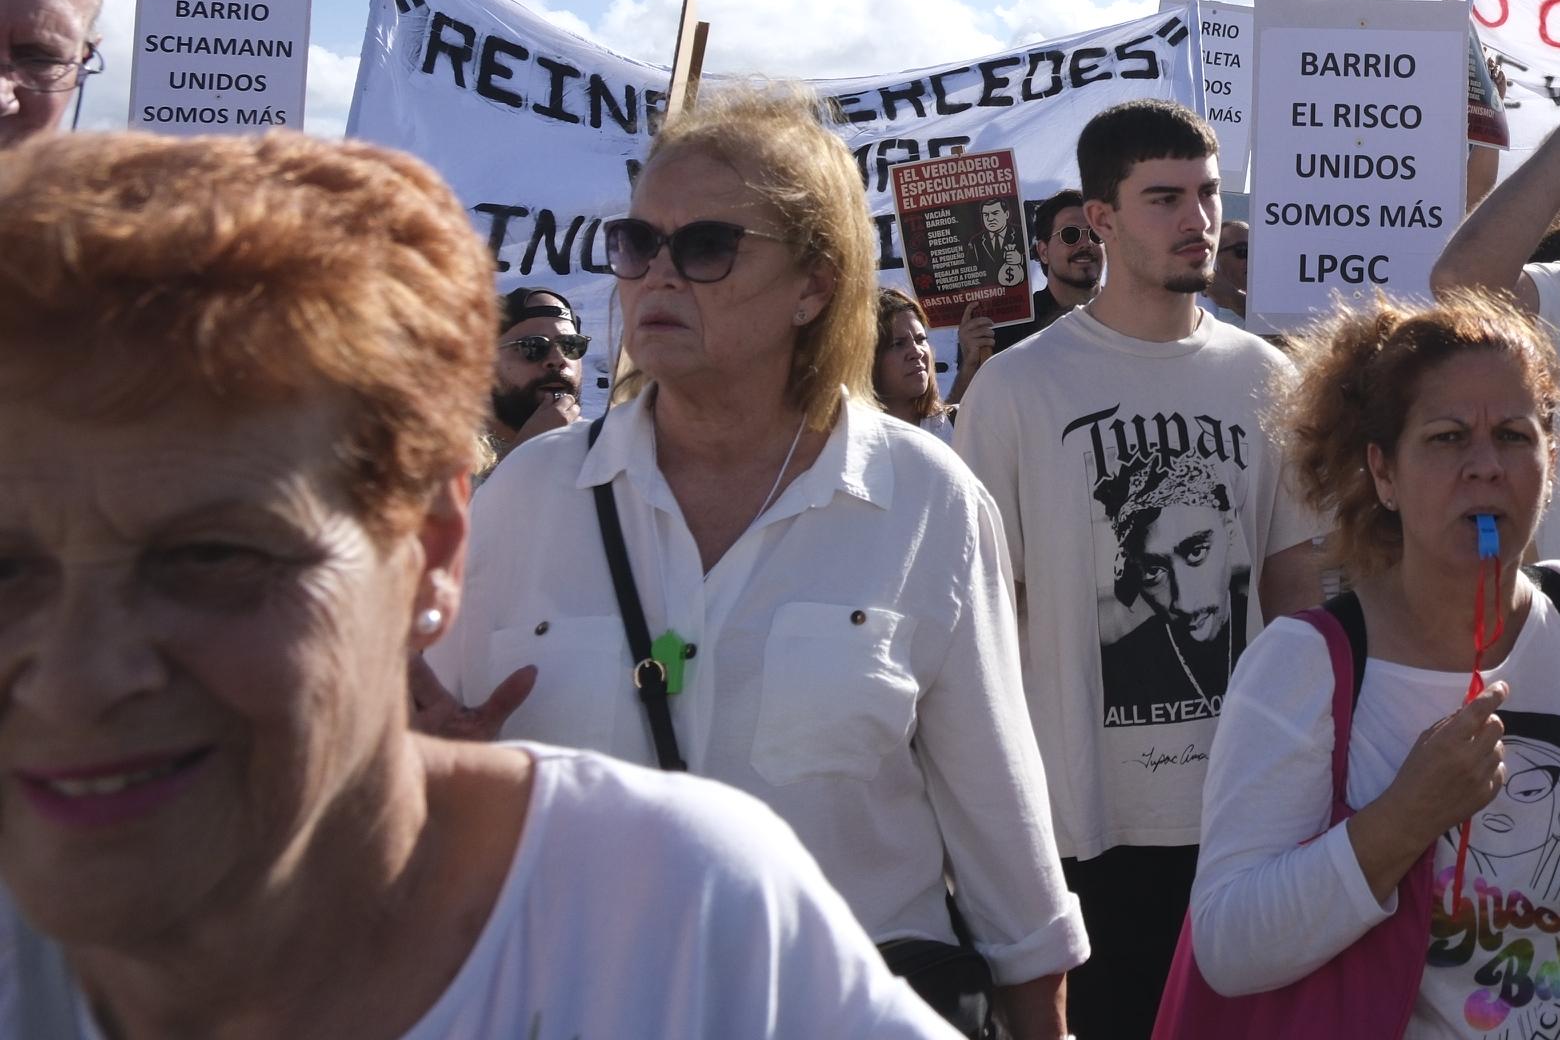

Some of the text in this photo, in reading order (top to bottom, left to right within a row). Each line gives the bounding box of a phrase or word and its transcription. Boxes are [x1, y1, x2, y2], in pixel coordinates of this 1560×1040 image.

[175, 0, 270, 22] BARRIO
[144, 34, 293, 58] SCHAMANN
[1301, 51, 1416, 79] BARRIO
[169, 71, 267, 93] UNIDOS
[143, 105, 287, 126] SOMOS MÁS
[1208, 106, 1242, 124] MÁS
[1292, 102, 1422, 130] EL RISCO
[899, 156, 999, 184] ¡EL VERDADERO
[1295, 153, 1416, 181] UNIDOS
[901, 168, 1013, 198] ESPECULADOR ES
[903, 182, 1012, 210] EL AYUNTAMIENTO!
[926, 216, 959, 228] BARRIOS.
[1264, 199, 1443, 229] SOMOS MÁS
[928, 228, 951, 240] SUBEN
[929, 236, 960, 248] PRECIOS.
[1299, 253, 1389, 285] LPGC
[923, 287, 1006, 308] ¡BASTA DE CINISMO!
[1105, 705, 1147, 726] ALL
[1150, 698, 1207, 723] EYEZ
